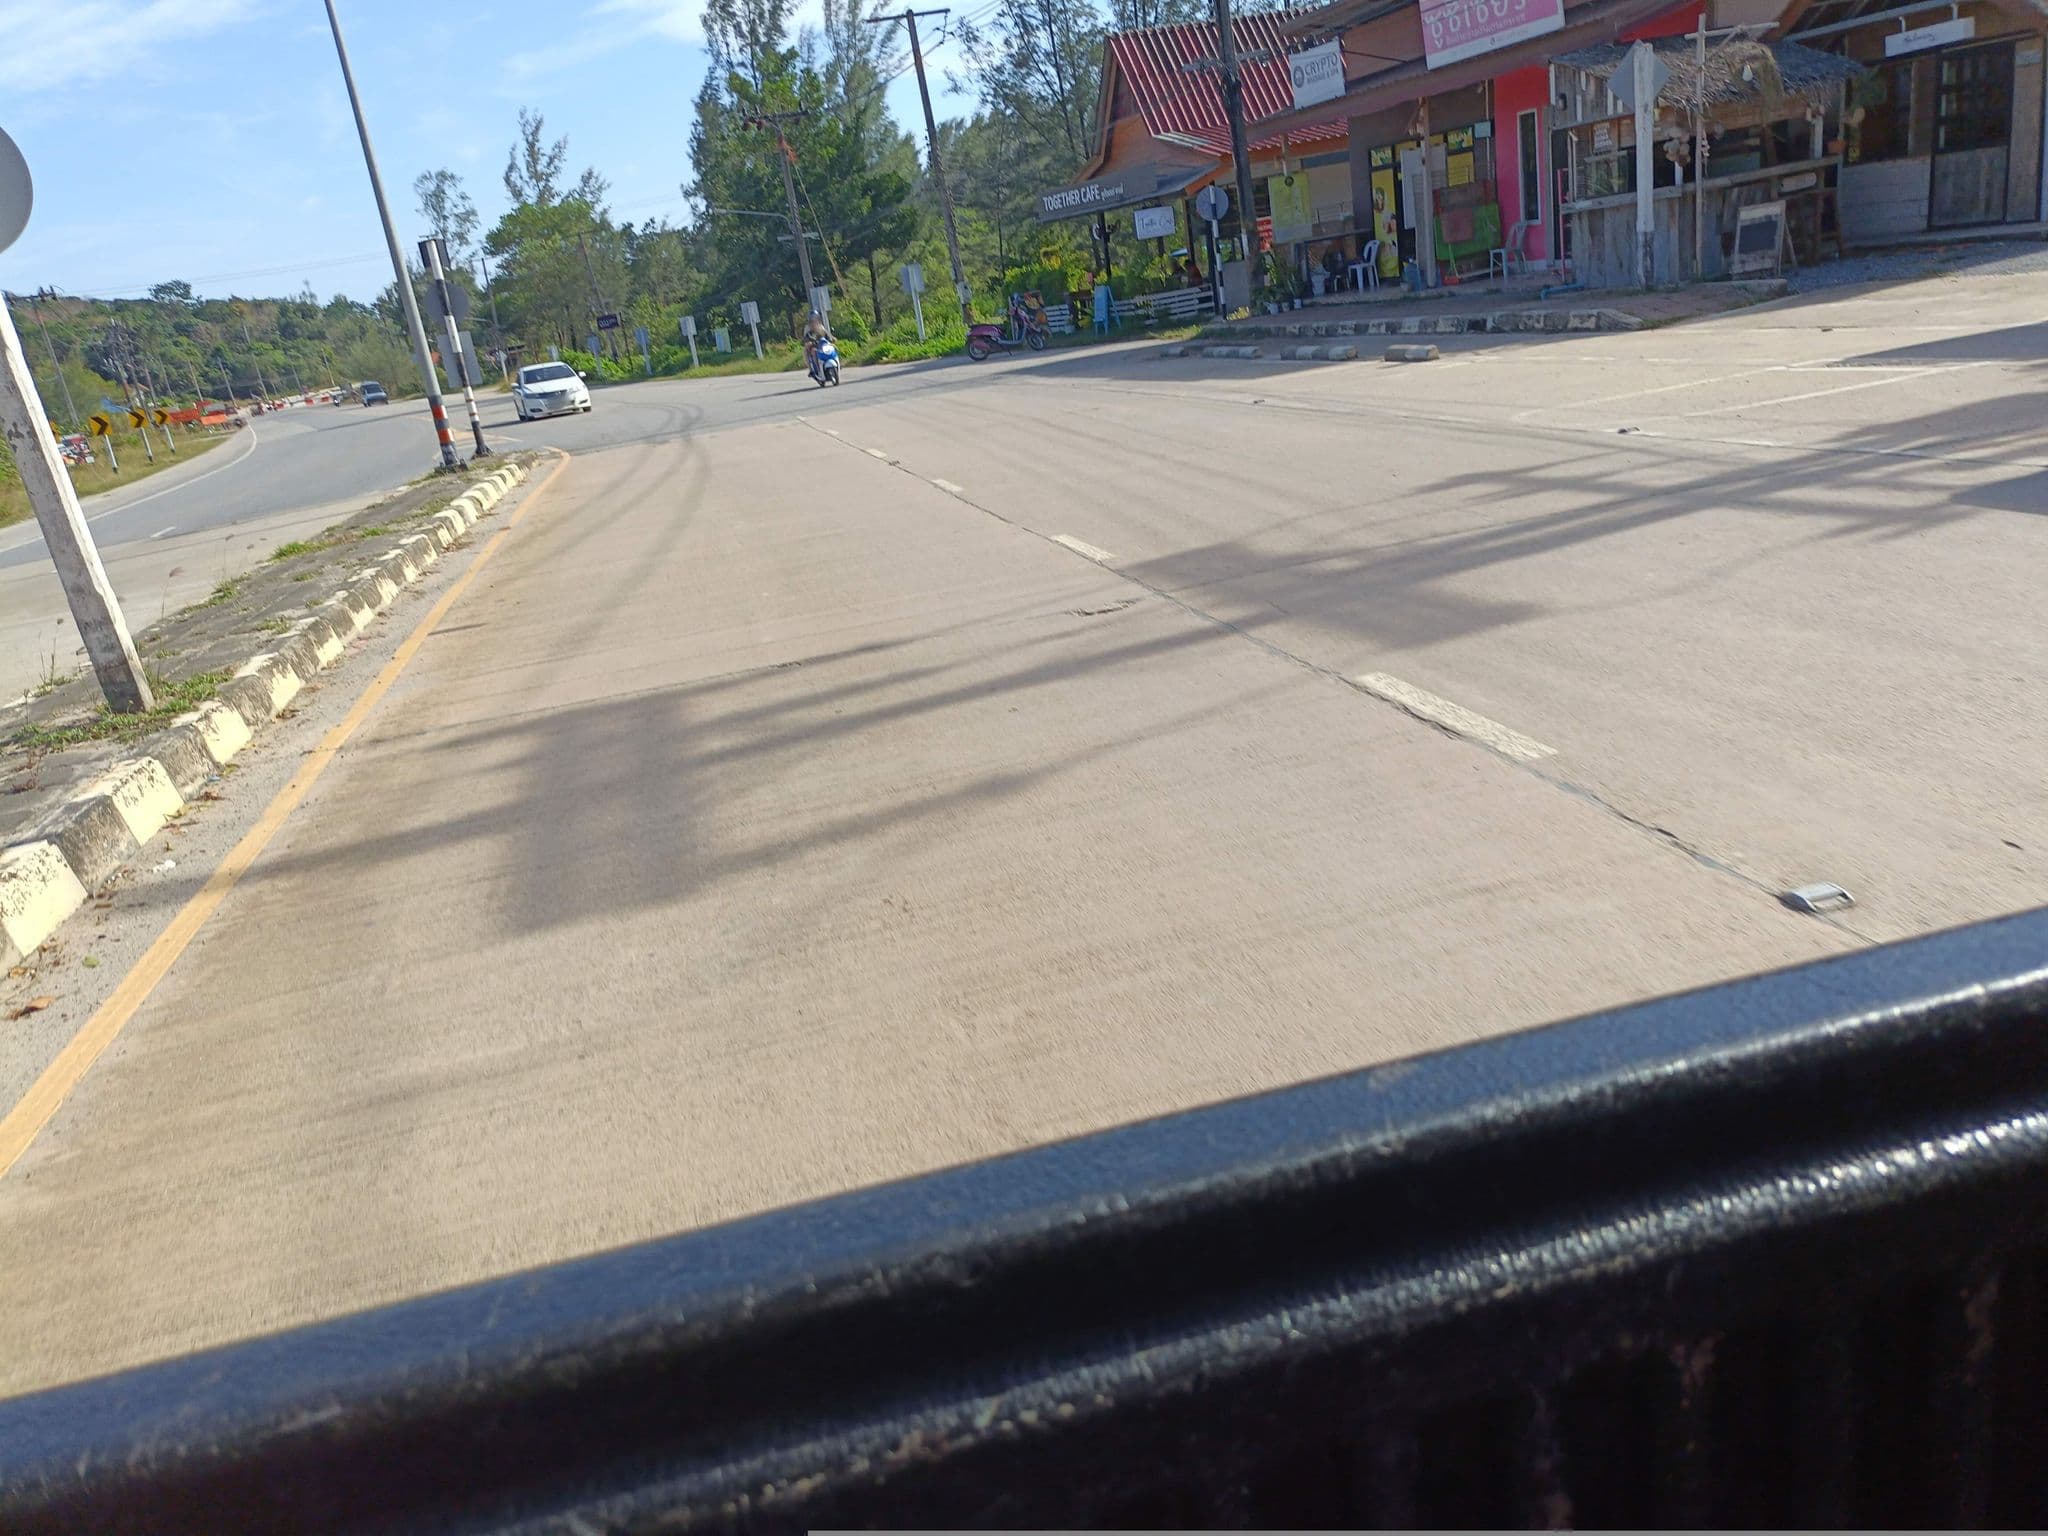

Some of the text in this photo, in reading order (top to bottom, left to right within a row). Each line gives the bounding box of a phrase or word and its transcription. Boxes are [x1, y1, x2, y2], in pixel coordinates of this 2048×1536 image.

[1305, 52, 1338, 76] CRYPTO
[1043, 188, 1081, 211] TOGETHER
[1081, 184, 1101, 203] CAFE
